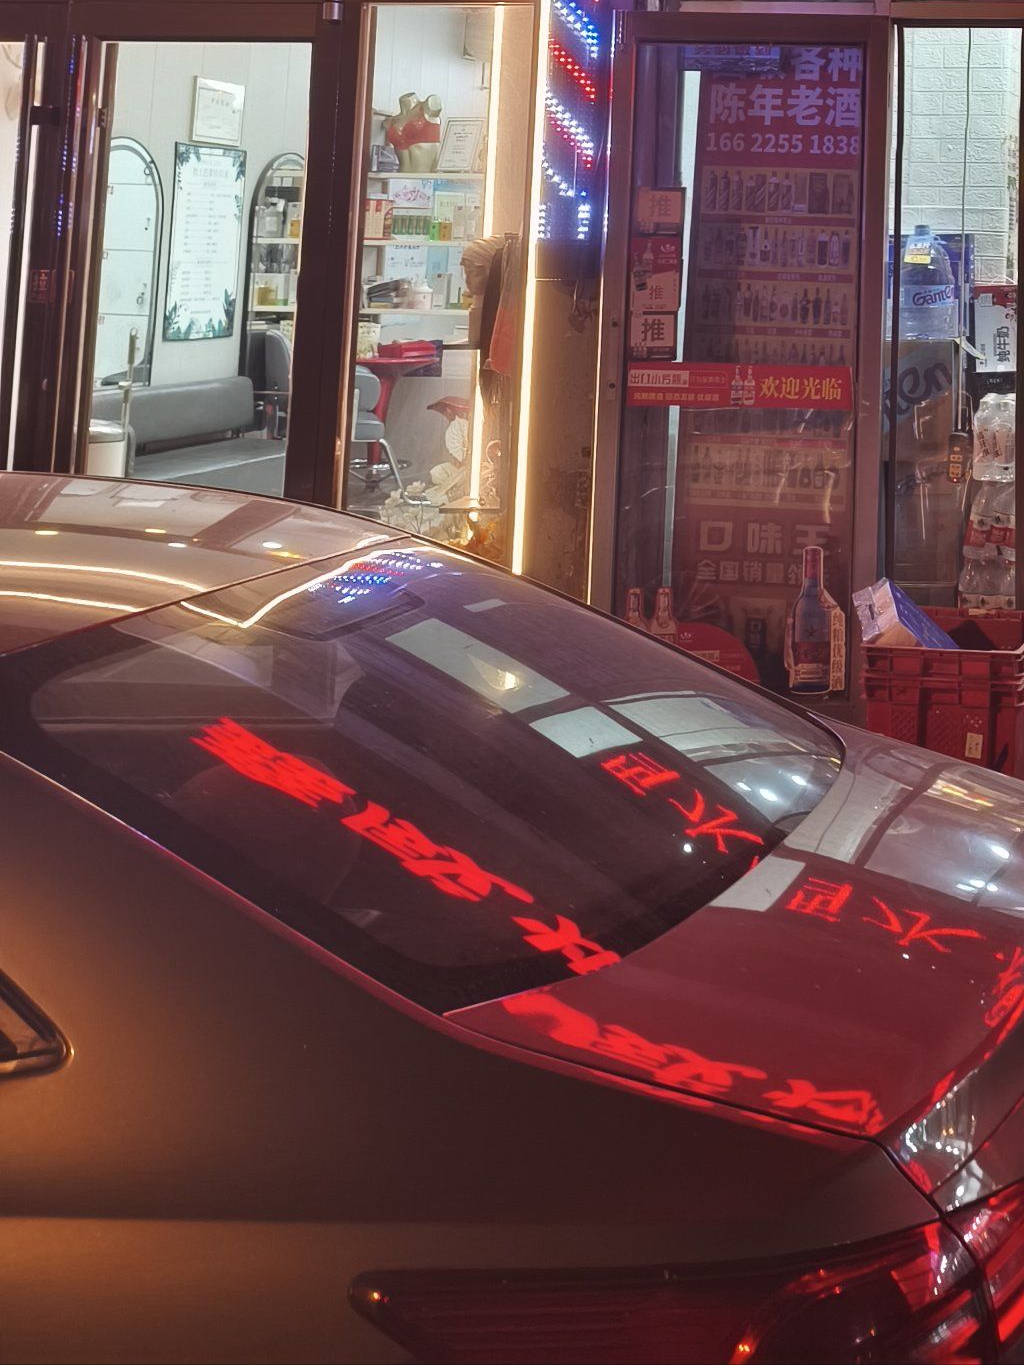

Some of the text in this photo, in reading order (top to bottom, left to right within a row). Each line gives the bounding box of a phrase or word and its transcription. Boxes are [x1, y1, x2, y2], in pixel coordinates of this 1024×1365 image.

[710, 83, 861, 127] 陈年老酒
[706, 132, 745, 152] 166
[751, 133, 803, 154] 2255
[642, 318, 665, 342] 推
[759, 376, 843, 401] 欢迎光临
[700, 521, 831, 556] 口味王
[697, 559, 829, 585] 全国销量领
